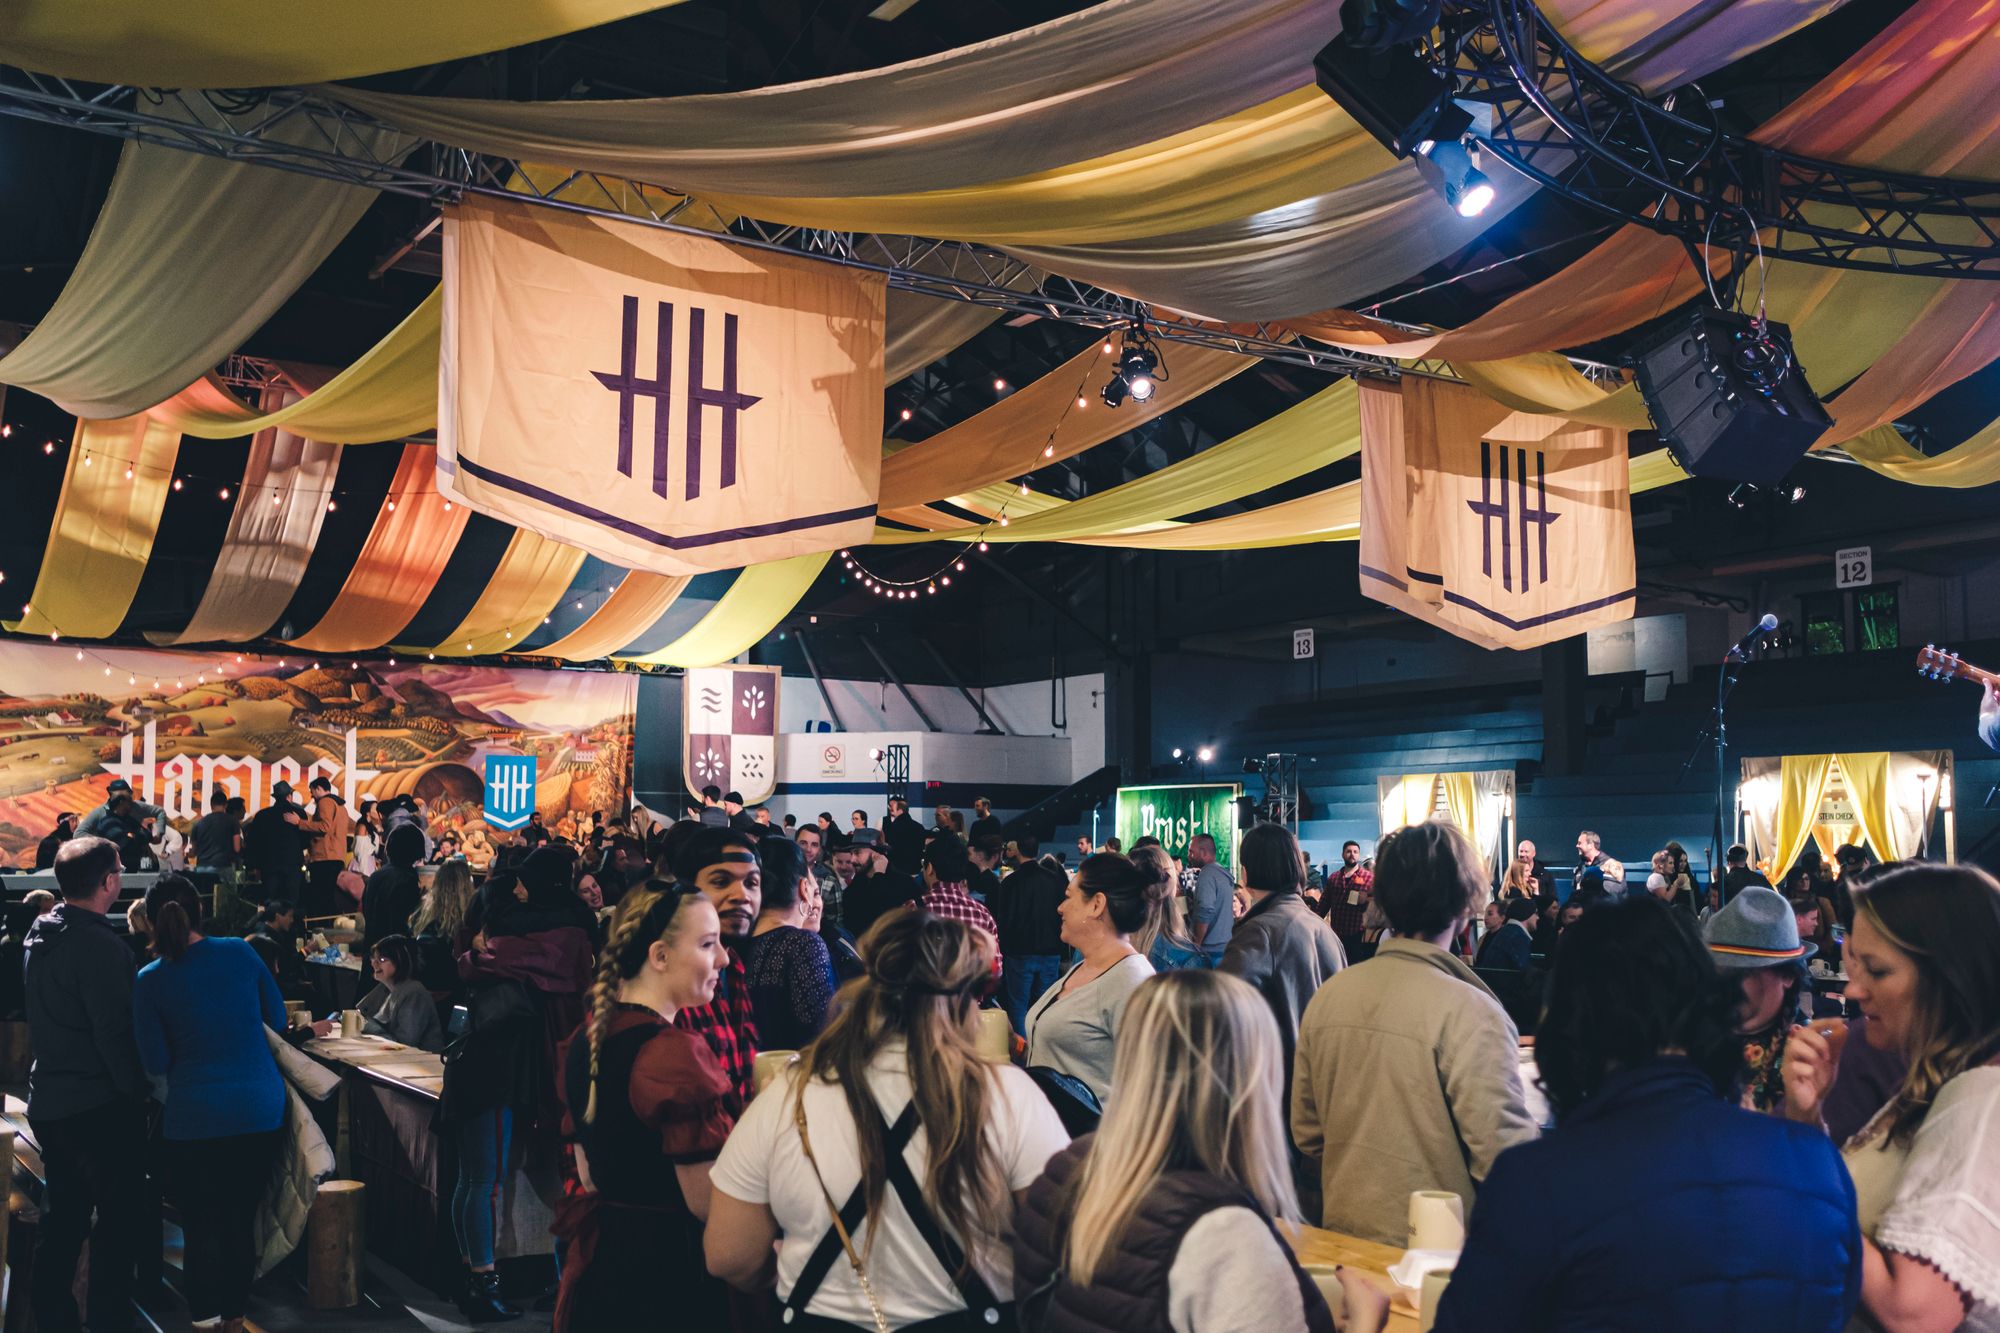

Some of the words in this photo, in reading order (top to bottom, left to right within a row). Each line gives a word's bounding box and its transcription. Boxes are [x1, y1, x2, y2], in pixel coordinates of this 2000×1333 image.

[1839, 550, 1868, 559] SECTION
[1841, 561, 1867, 583] 12
[1296, 639, 1311, 655] 13
[1818, 812, 1834, 820] STEIN
[1835, 812, 1854, 820] CHECK
